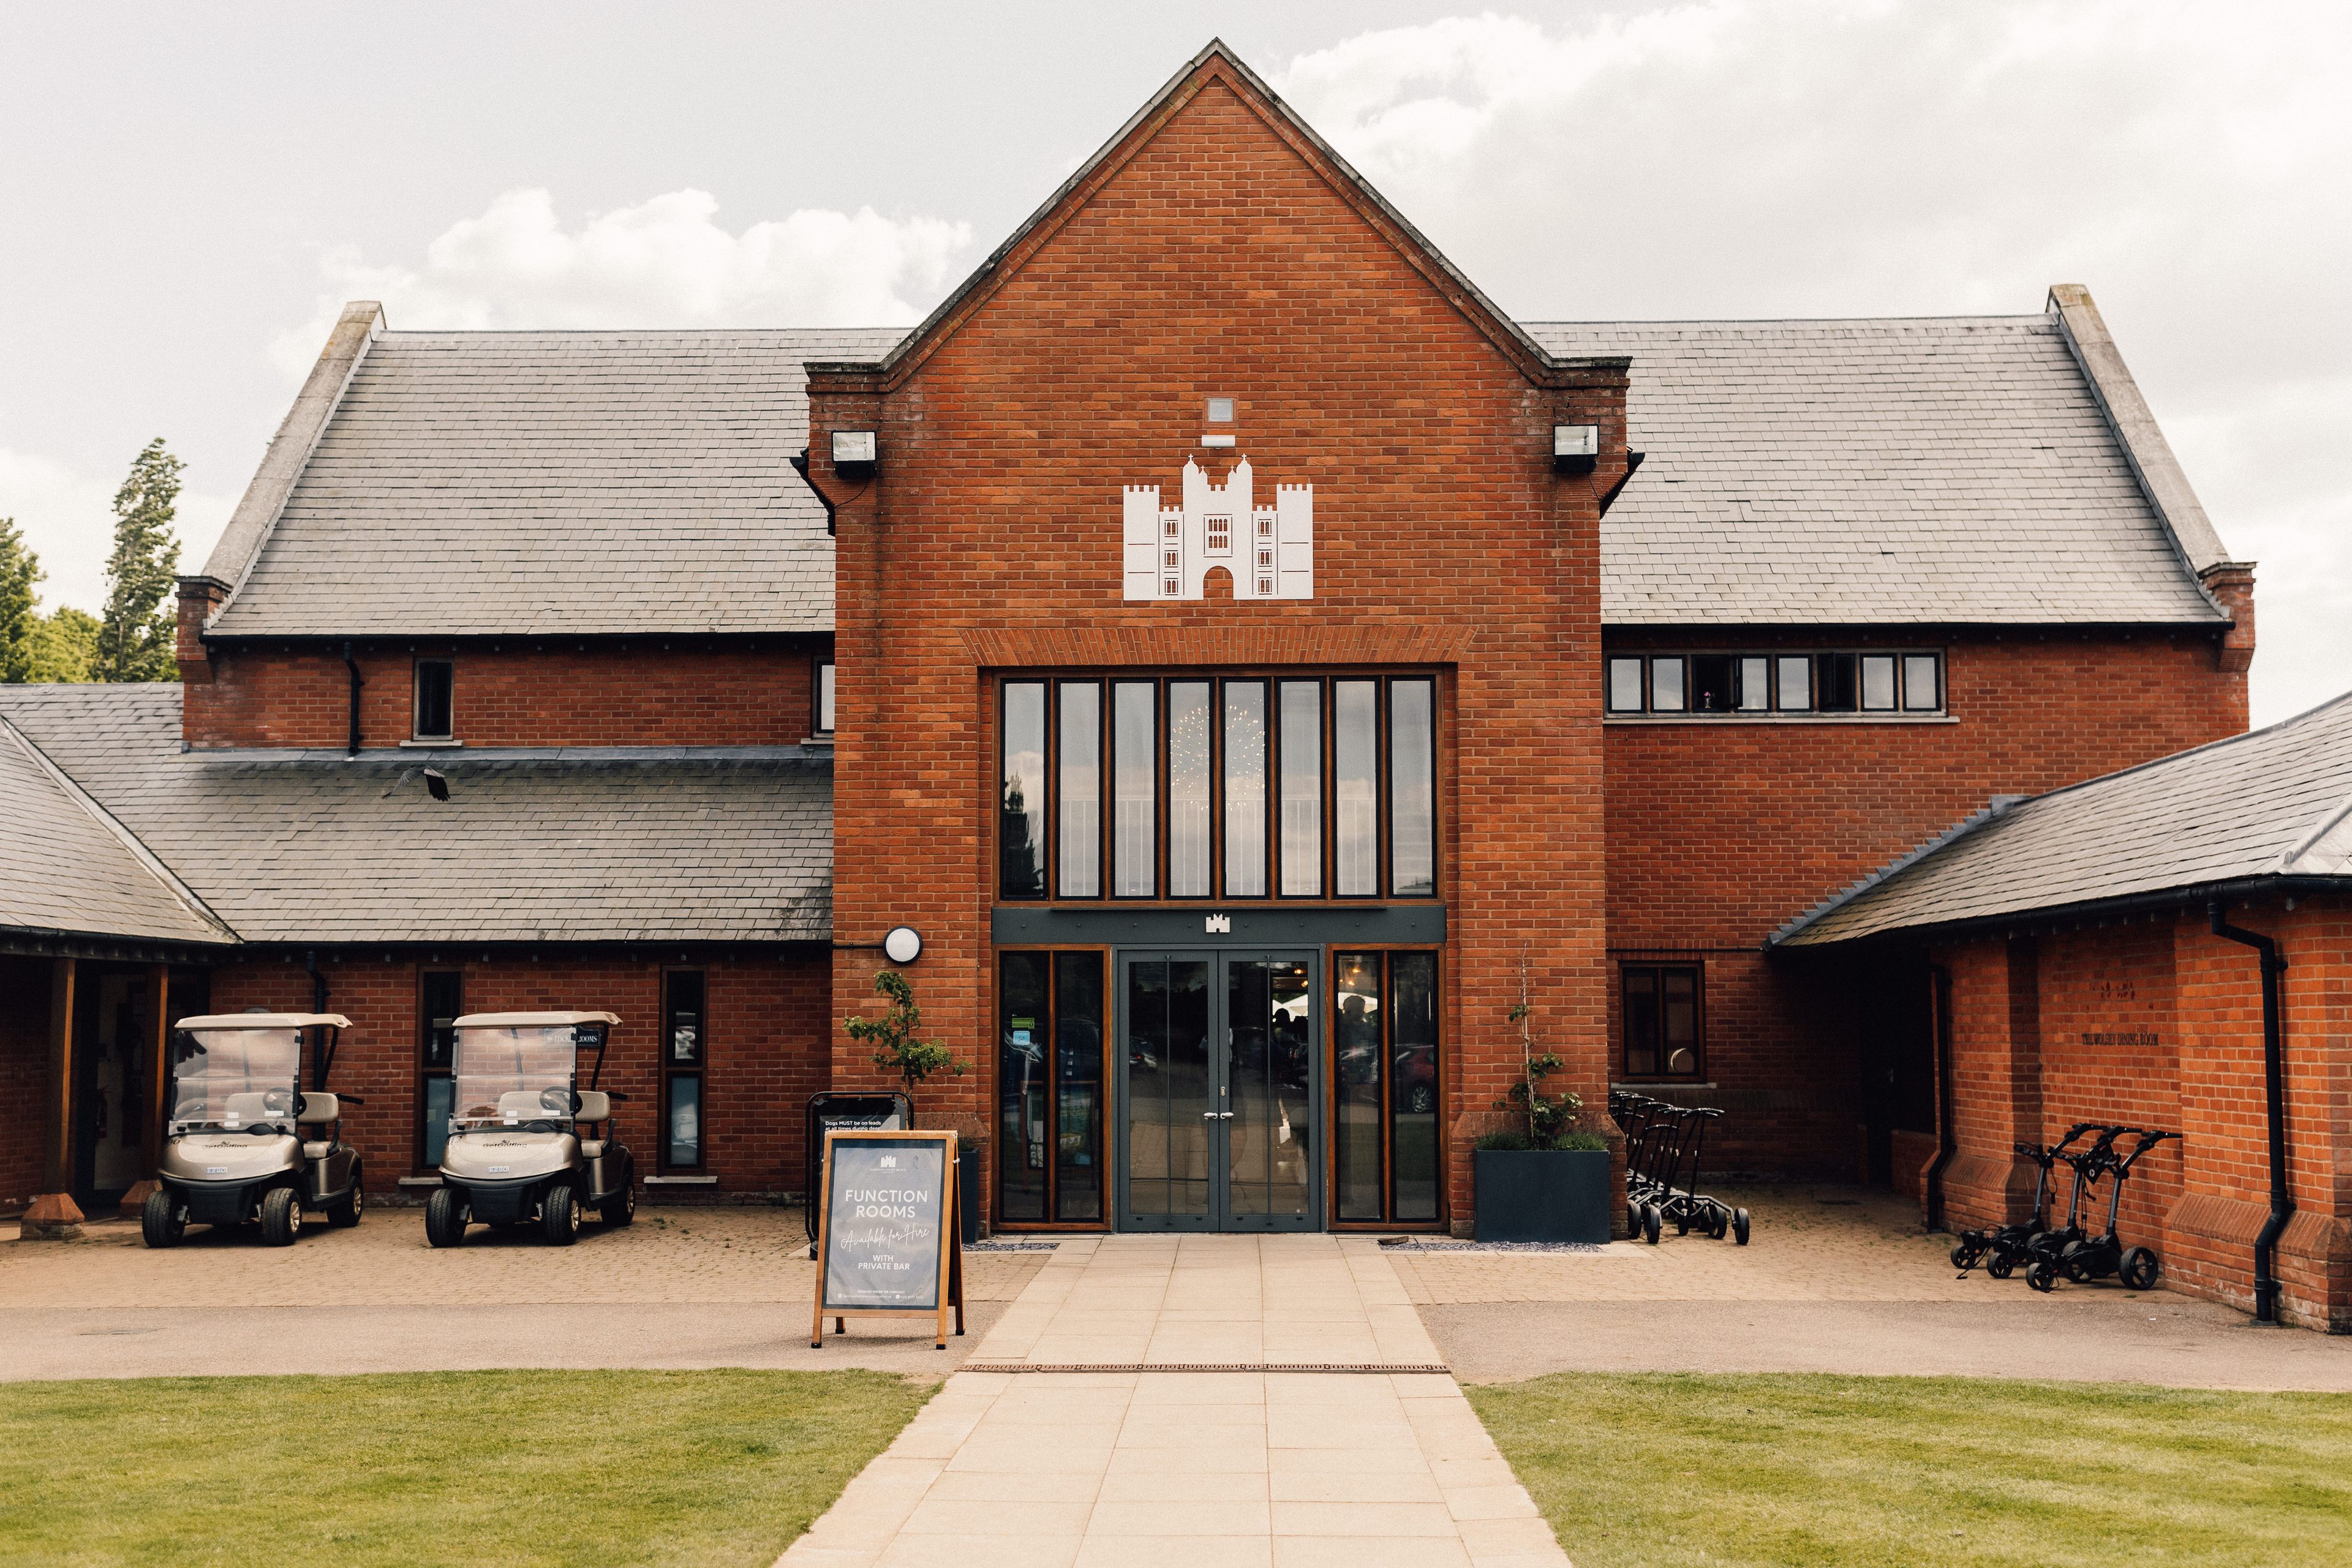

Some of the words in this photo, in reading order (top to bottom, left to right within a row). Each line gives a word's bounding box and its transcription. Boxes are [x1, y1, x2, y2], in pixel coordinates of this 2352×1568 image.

[2081, 1033, 2094, 1045] THE
[2094, 1033, 2116, 1045] WOLSEY
[2117, 1033, 2138, 1046] DINING
[2140, 1033, 2158, 1046] ROOM
[845, 1189, 928, 1203] FUNCTION
[856, 1205, 916, 1218] ROOMS
[840, 1227, 887, 1252] Available
[888, 1229, 903, 1249] for
[903, 1223, 930, 1245] Hire
